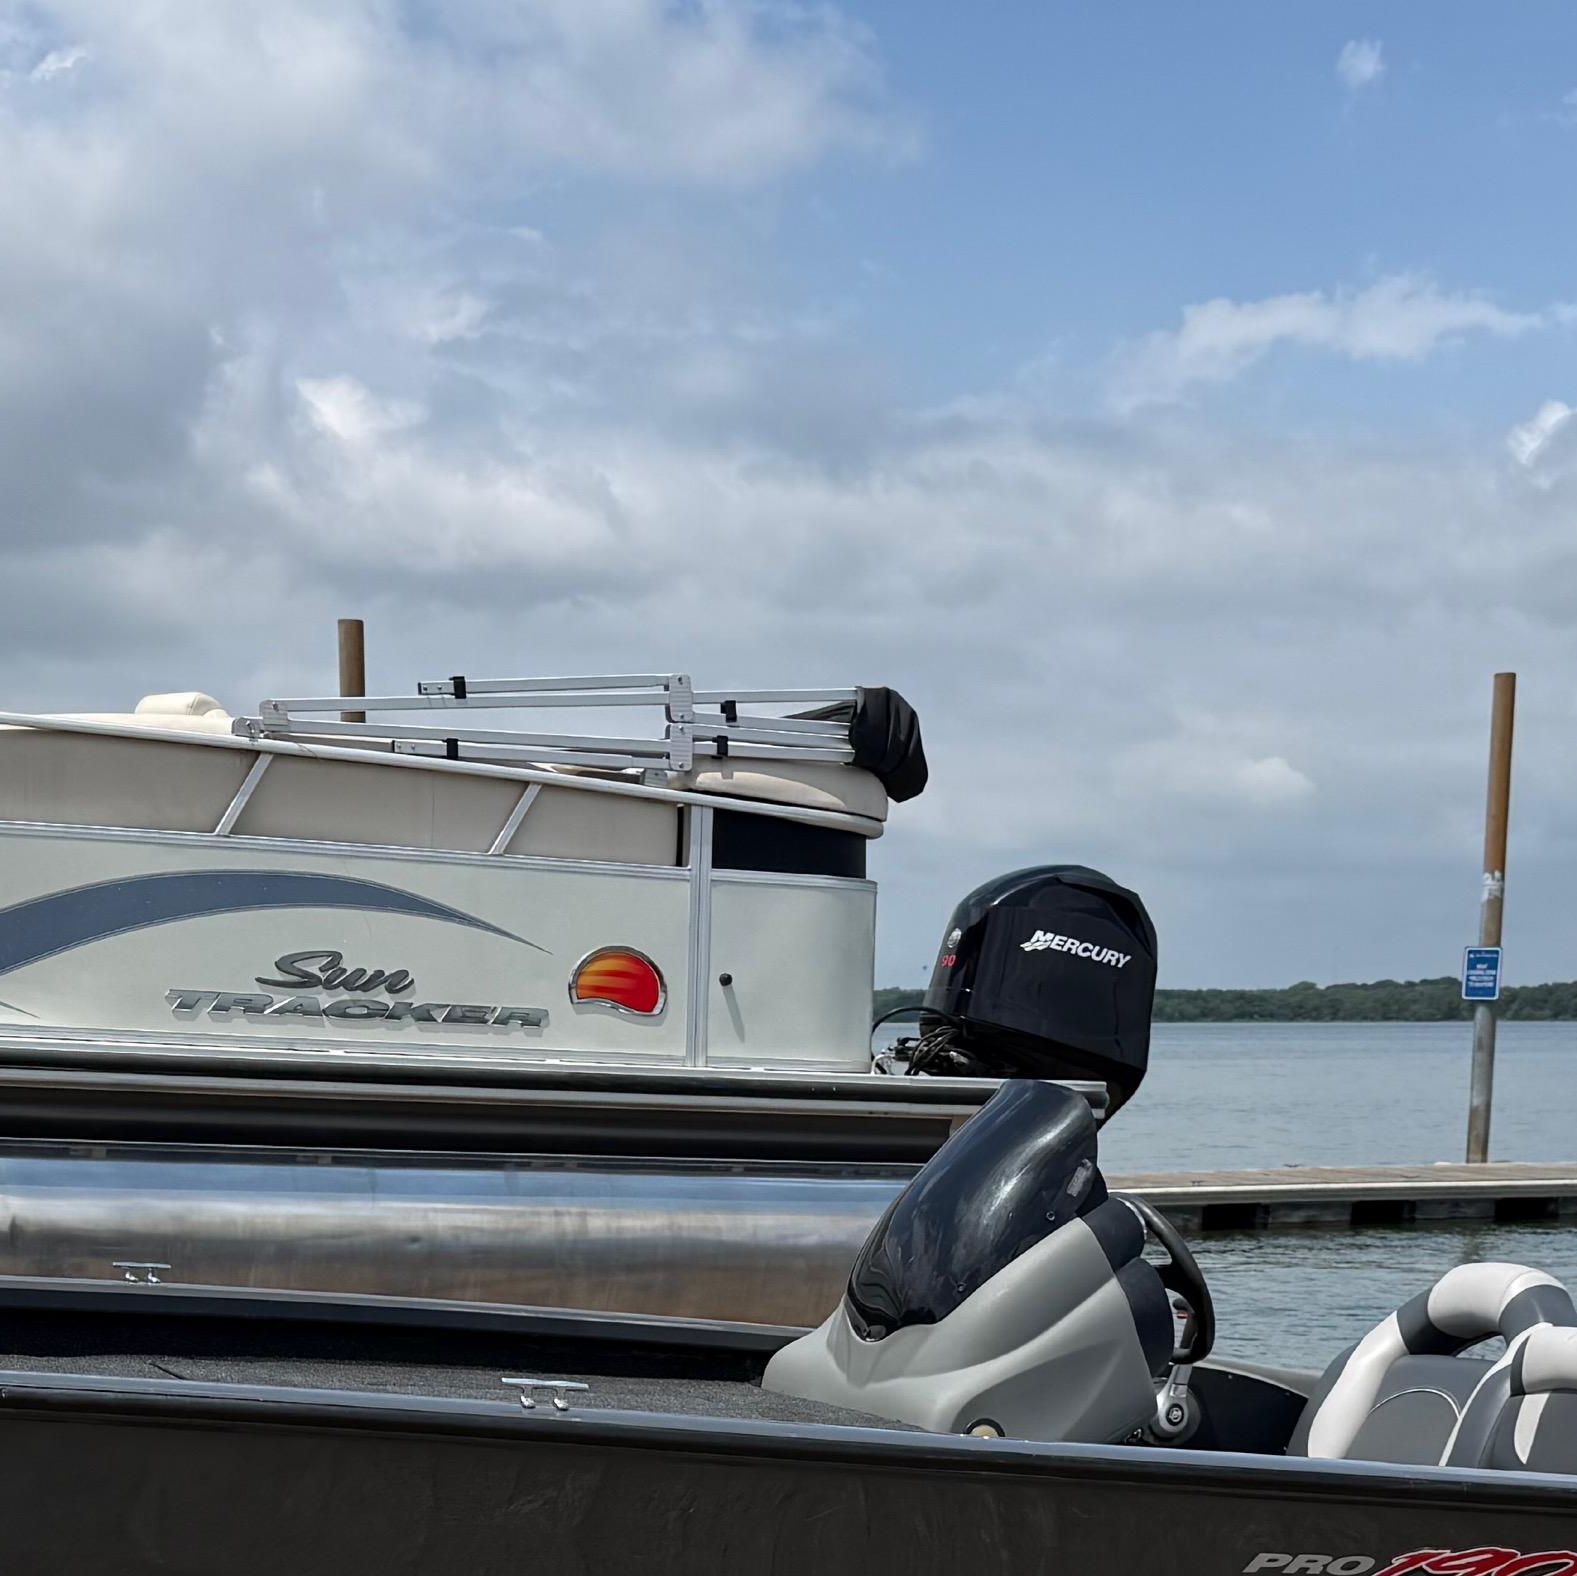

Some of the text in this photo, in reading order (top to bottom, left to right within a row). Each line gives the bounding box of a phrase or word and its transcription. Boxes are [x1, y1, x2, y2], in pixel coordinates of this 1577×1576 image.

[1020, 929, 1132, 969] MERCURY
[254, 950, 415, 995] Sun
[166, 988, 550, 1029] TRACKER
[1242, 1551, 1375, 1576] PRO
